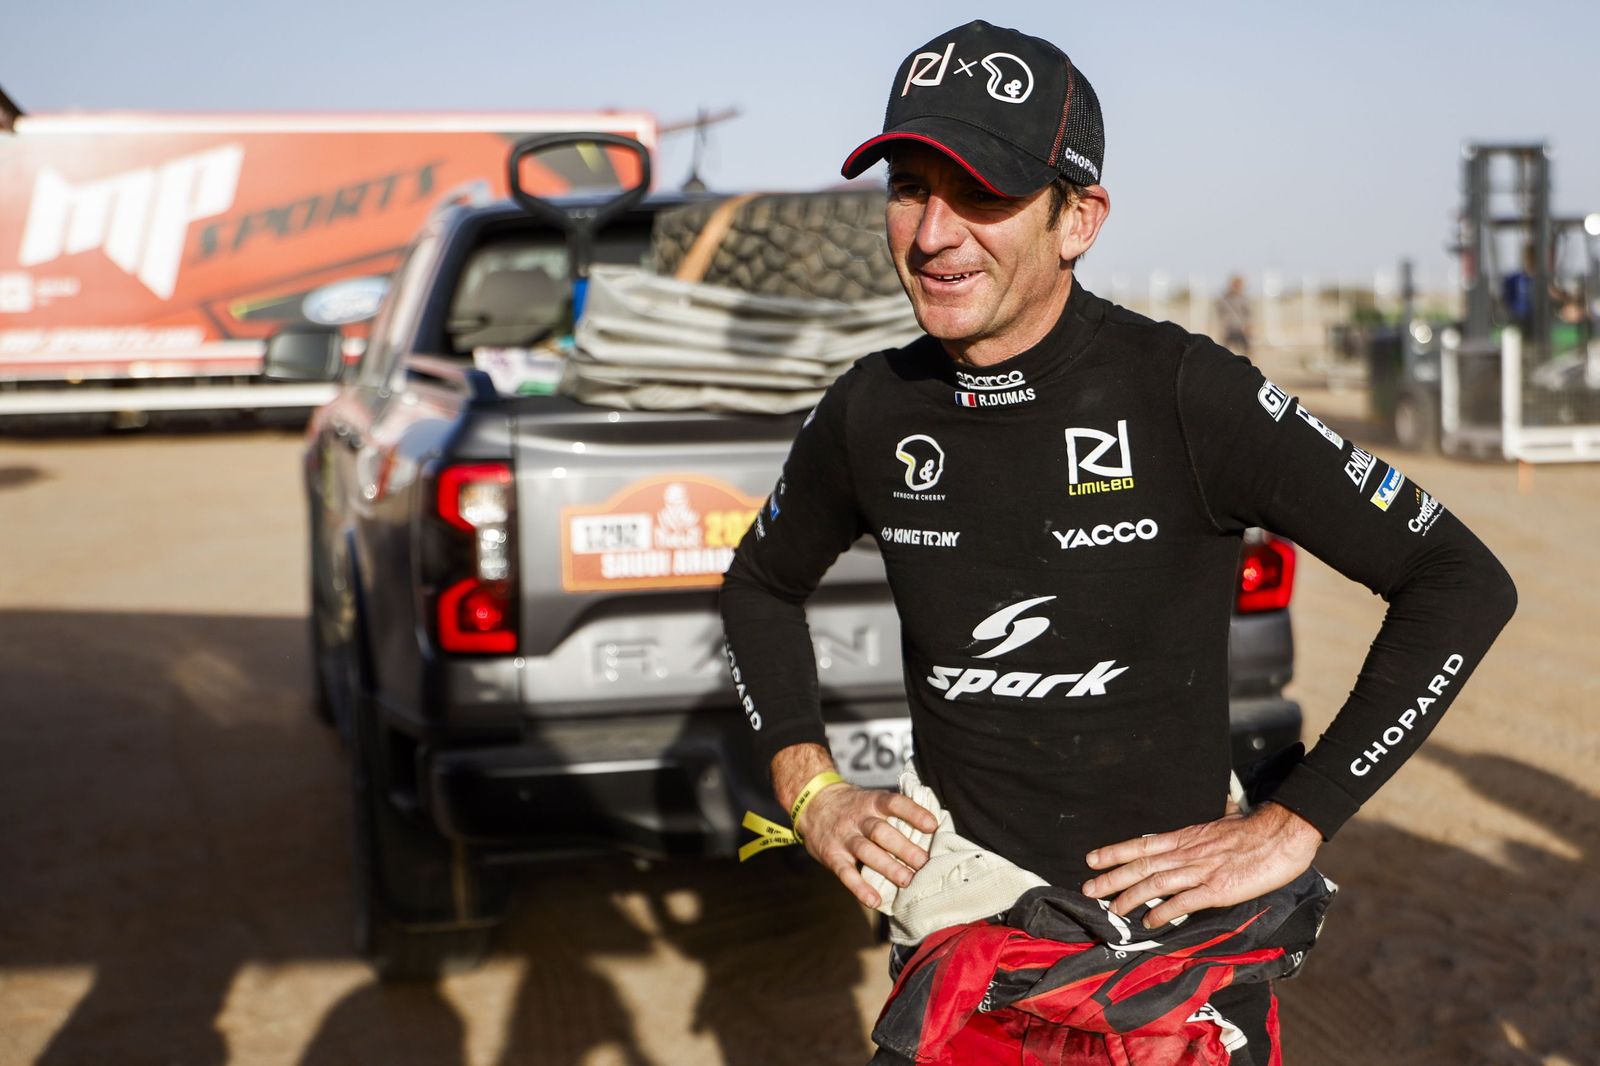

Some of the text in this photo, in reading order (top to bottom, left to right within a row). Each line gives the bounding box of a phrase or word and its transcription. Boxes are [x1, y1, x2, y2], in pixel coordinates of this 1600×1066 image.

[956, 370, 1026, 390] sparco
[978, 387, 1036, 407] R.DUMAS
[893, 528, 921, 545] KING
[1051, 518, 1159, 550] YACCO
[926, 659, 1131, 701] spark
[1350, 653, 1465, 777] CHOPARD
